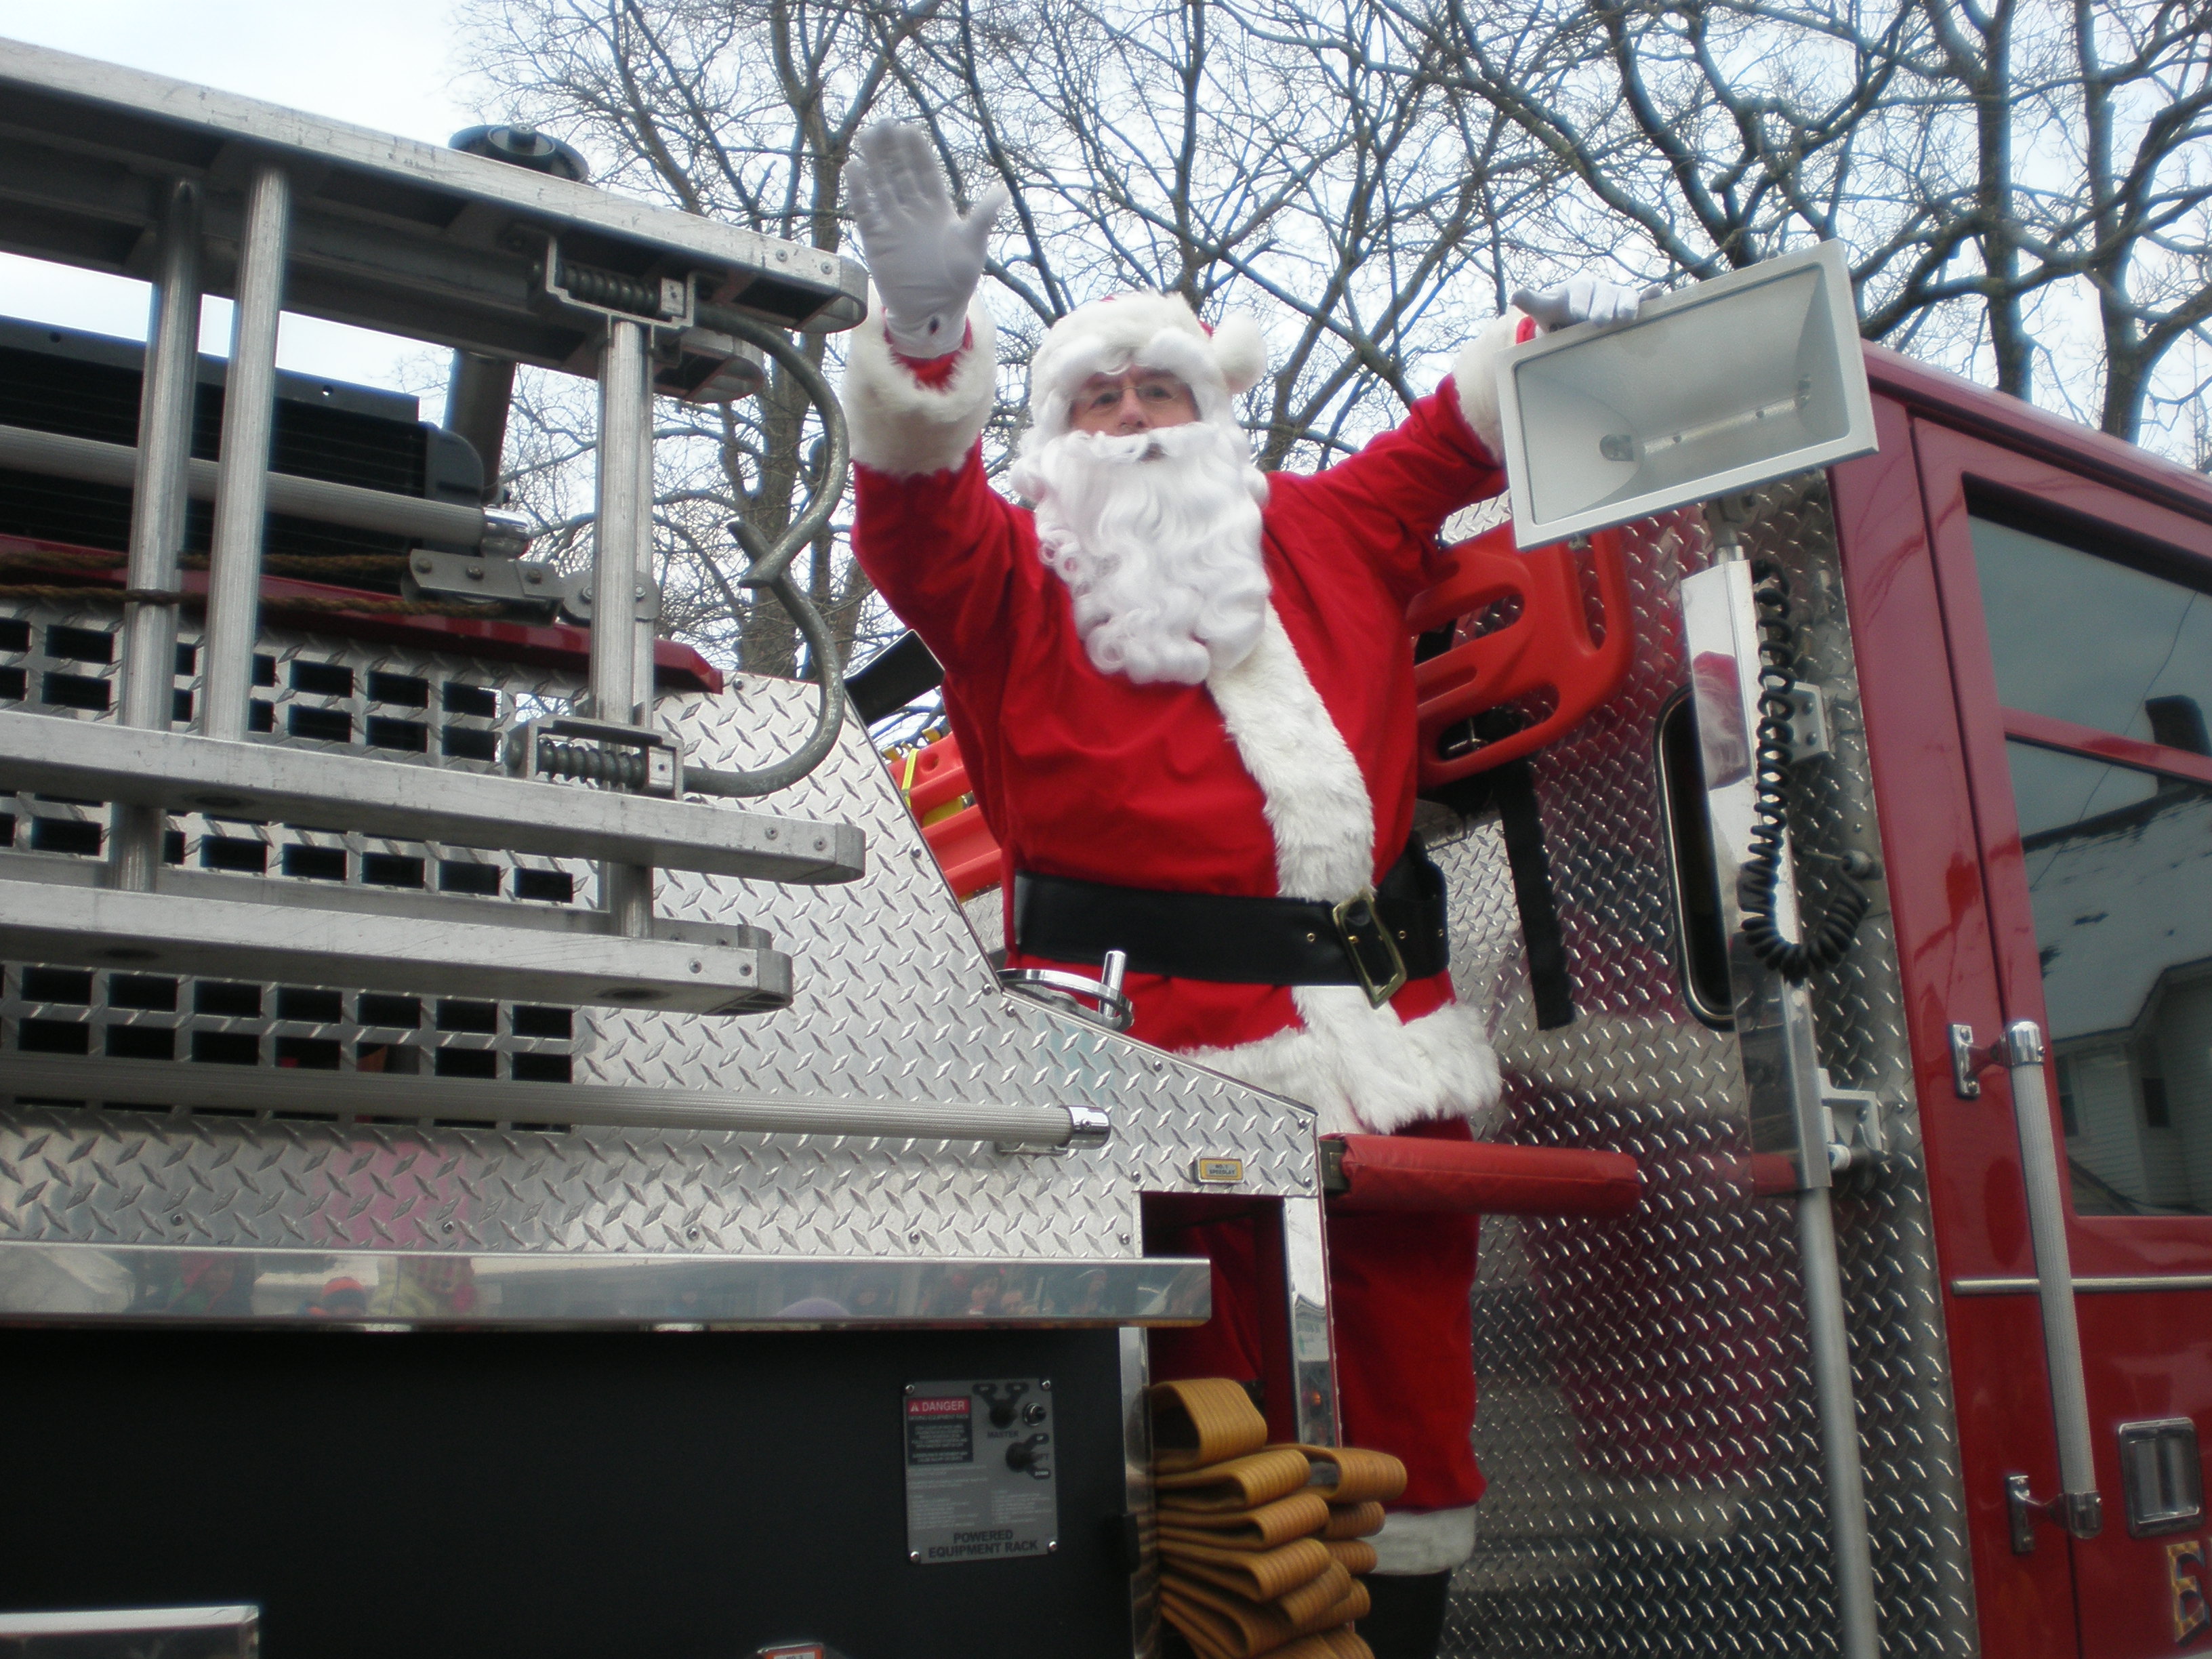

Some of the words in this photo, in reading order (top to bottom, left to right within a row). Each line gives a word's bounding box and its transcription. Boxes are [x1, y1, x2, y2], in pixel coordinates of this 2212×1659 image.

[922, 1400, 965, 1412] DANGER
[954, 1530, 1013, 1543] POWERED
[928, 1543, 1002, 1557] EQUIPMENT
[1006, 1540, 1038, 1553] RACK
[2167, 1537, 2212, 1647] E
